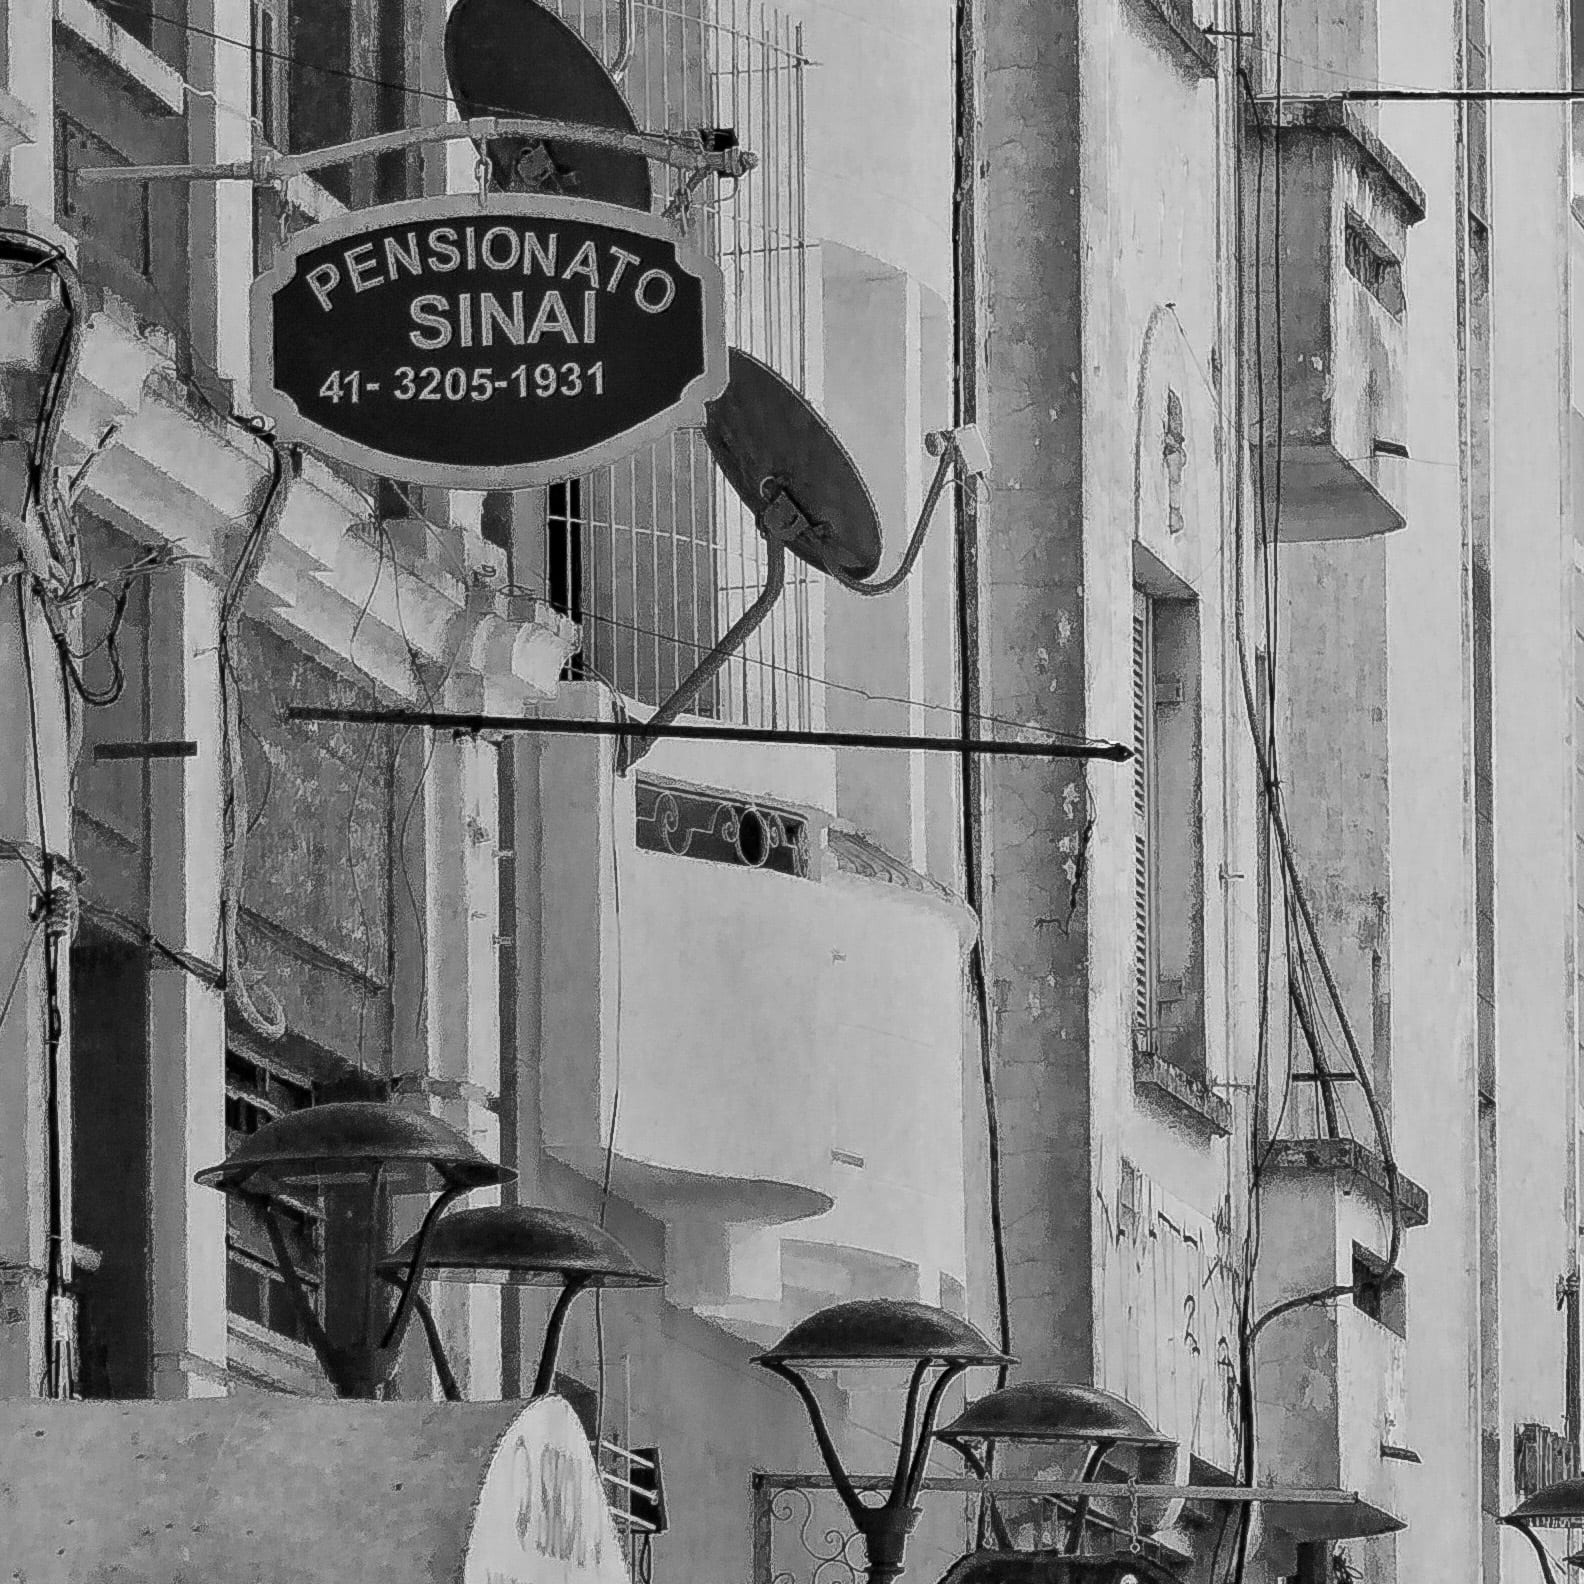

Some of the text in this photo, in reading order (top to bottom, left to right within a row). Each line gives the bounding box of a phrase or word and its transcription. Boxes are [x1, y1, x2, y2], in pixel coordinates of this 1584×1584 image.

[306, 226, 676, 314] PENSIONATO
[409, 290, 598, 350] SINAI
[394, 361, 605, 402] 3205-1931
